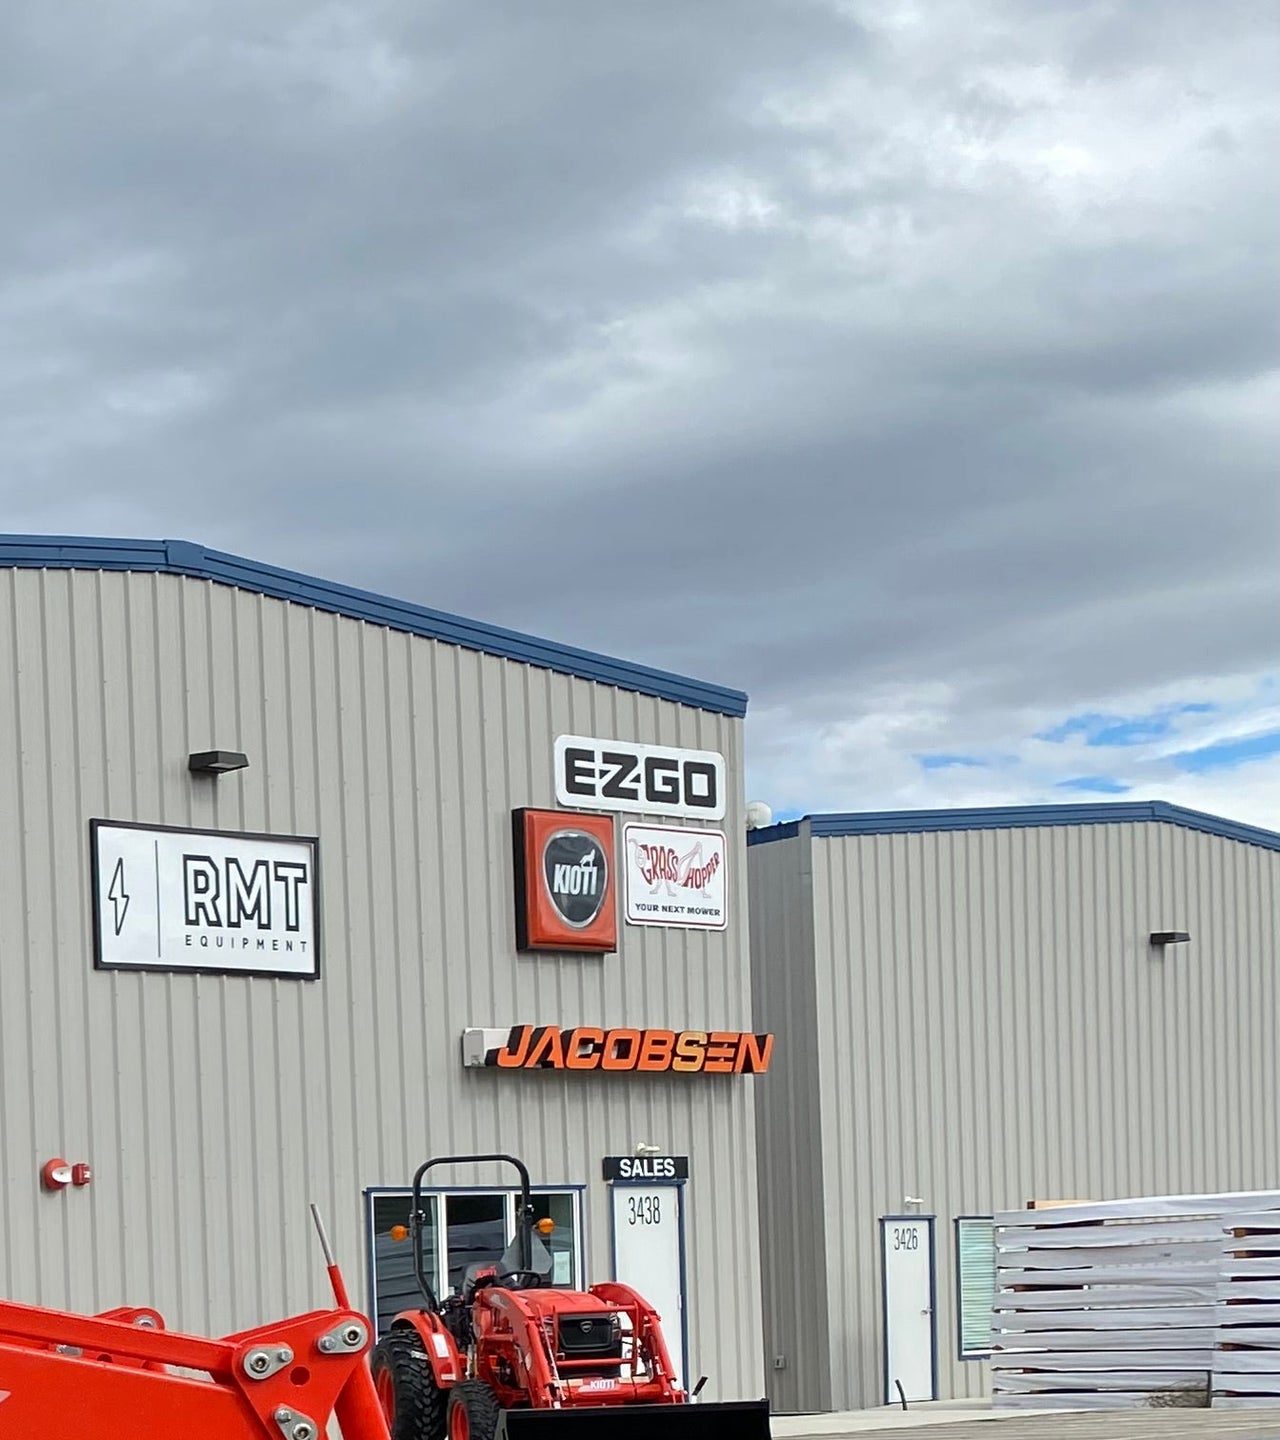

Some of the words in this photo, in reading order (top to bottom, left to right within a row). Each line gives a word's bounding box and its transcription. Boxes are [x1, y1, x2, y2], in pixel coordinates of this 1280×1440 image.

[565, 747, 717, 808] EZGO
[183, 853, 307, 932] RMT
[553, 862, 598, 896] KIOTI
[635, 903, 660, 913] YOUR
[661, 904, 685, 914] NEXT
[687, 906, 721, 917] MOWER
[184, 934, 308, 953] EQUIPMENT
[496, 1024, 775, 1074] JACOBSEN
[619, 1157, 675, 1178] SALES
[628, 1195, 661, 1225] 3438
[893, 1227, 919, 1251] 3426
